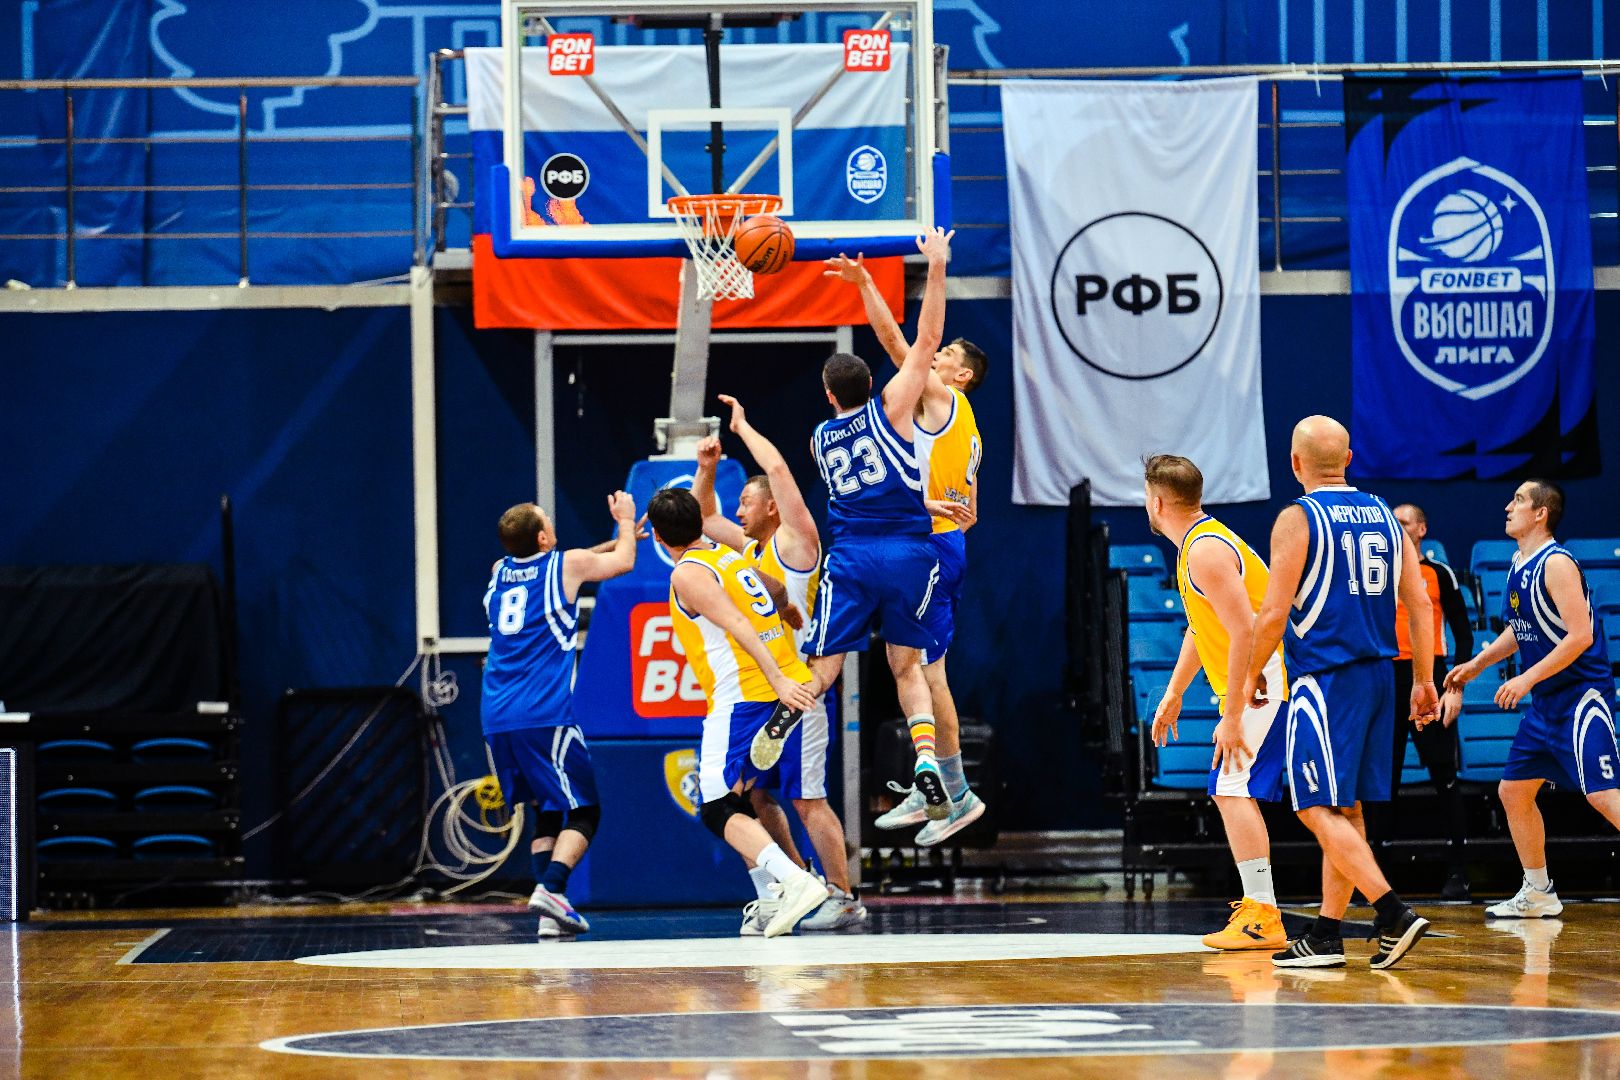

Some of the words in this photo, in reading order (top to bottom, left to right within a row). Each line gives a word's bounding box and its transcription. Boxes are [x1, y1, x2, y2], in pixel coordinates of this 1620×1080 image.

[550, 36, 592, 55] FON
[847, 33, 887, 52] FON
[550, 54, 592, 72] BET
[847, 50, 888, 68] BET
[547, 170, 584, 185] РФБ
[1427, 271, 1515, 289] FONBET
[1075, 272, 1201, 316] РФБ
[1413, 300, 1534, 340] ВЫСШАЯ
[1434, 345, 1515, 365] ЛИГА
[826, 435, 888, 496] 23
[1327, 505, 1385, 524] МЕРКУЛОВ
[1341, 530, 1389, 596] 16
[1521, 569, 1531, 589] 5
[736, 567, 777, 618] 9
[498, 585, 528, 636] 8
[640, 659, 708, 703] BE
[1598, 755, 1615, 780] 5
